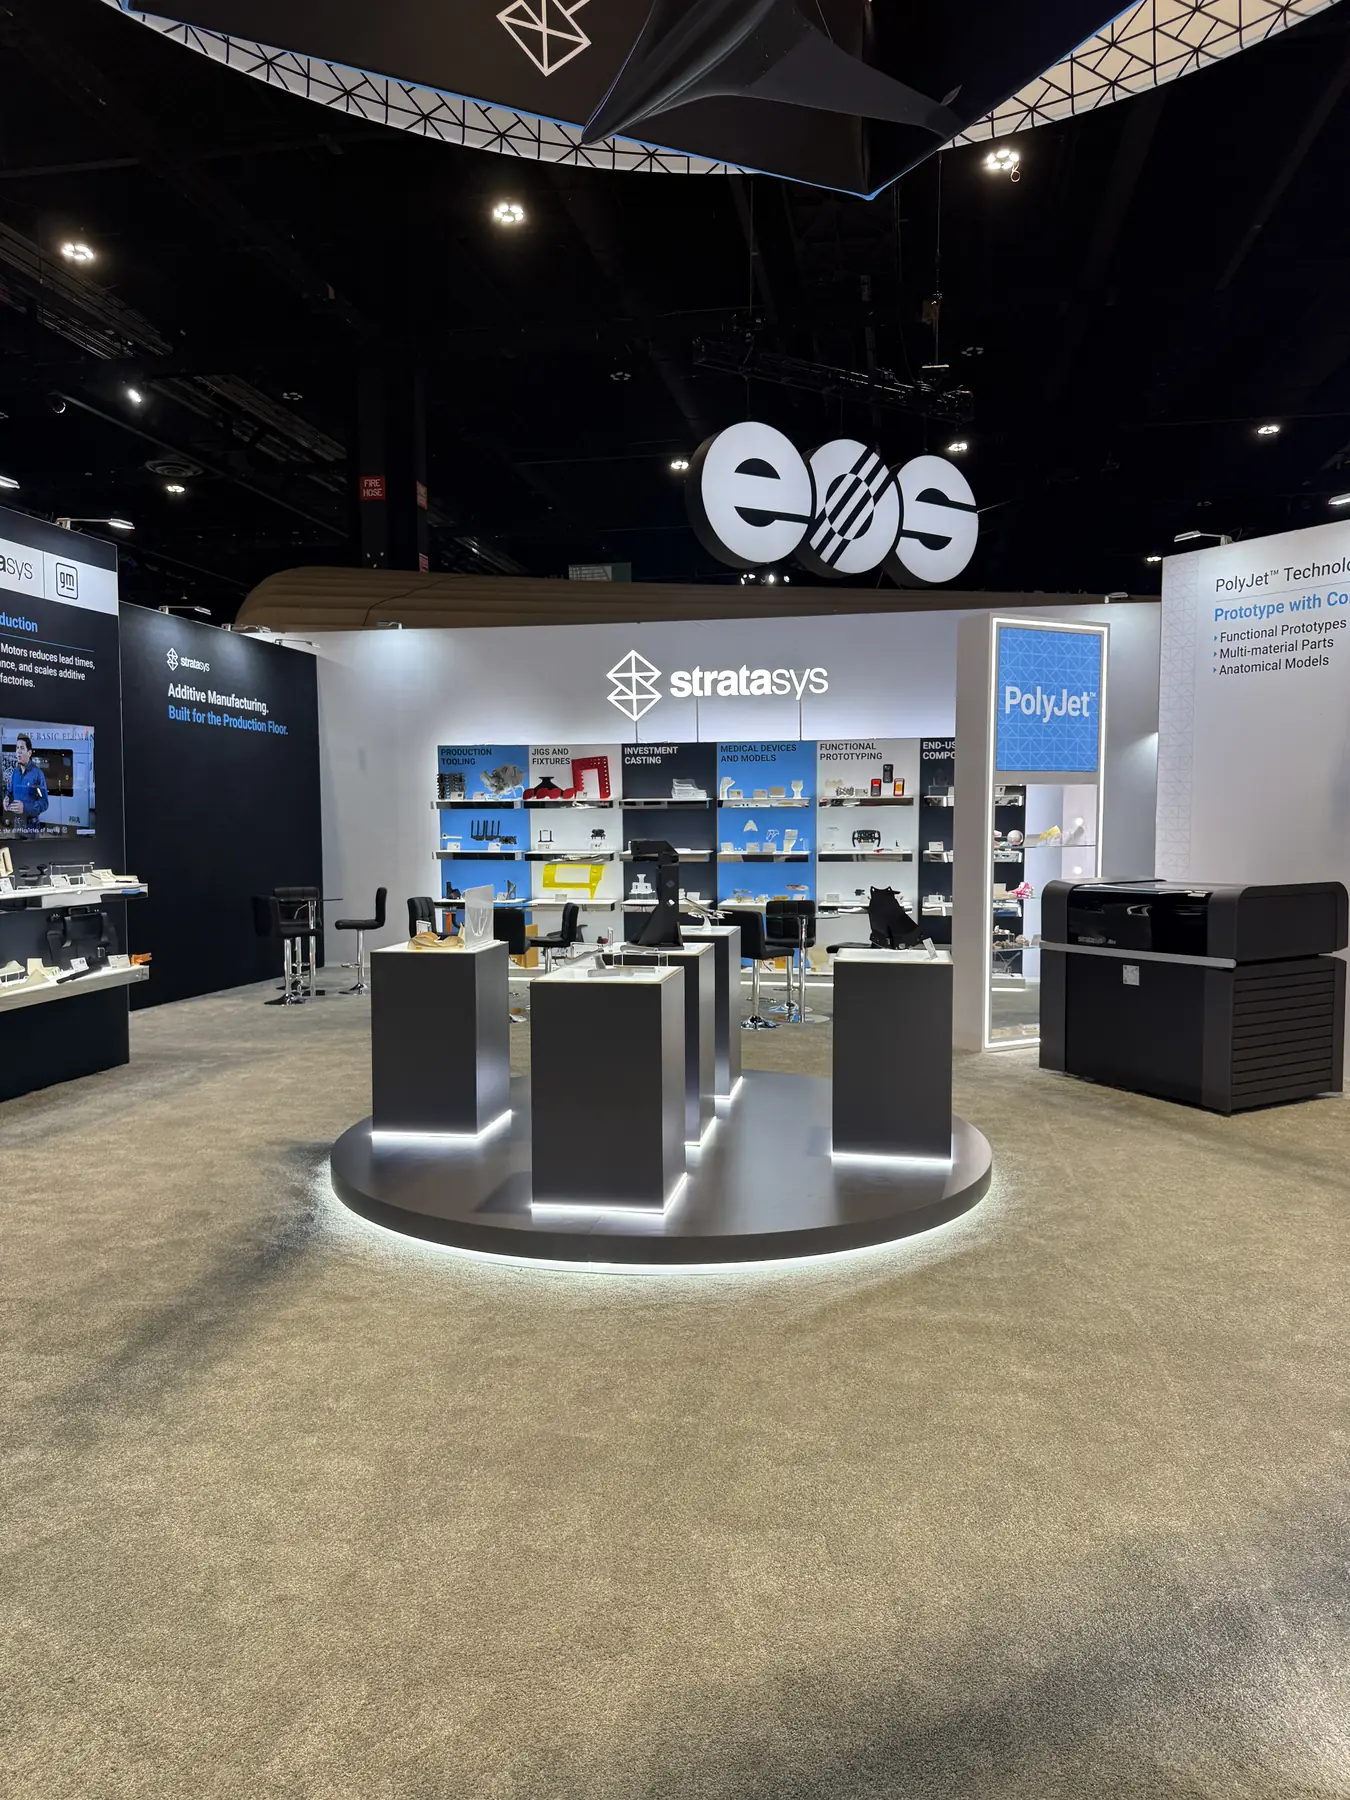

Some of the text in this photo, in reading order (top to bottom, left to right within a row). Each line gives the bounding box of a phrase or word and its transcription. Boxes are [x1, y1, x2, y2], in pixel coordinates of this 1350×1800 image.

[364, 479, 381, 487] FIRE
[363, 488, 383, 496] HOSE
[701, 421, 979, 583] eos
[1214, 591, 1350, 622] Prototype with Co
[1220, 619, 1347, 643] Functional Prototypes
[1219, 637, 1335, 659] Multi-material Parts
[0, 643, 96, 670] Motors reduces lead times,
[180, 657, 210, 672] stratasys
[1218, 654, 1330, 676] Anatomical Models
[18, 663, 33, 673] and
[34, 666, 58, 677] scales
[58, 669, 86, 681] additive
[669, 664, 829, 701] stratasys
[168, 683, 269, 716] Additive Manufacturing.
[168, 704, 288, 735] Built for the Production Floor.
[624, 746, 678, 755] INVESTMENT
[720, 743, 797, 753] MEDICAL DEVICES
[819, 742, 876, 751] FUNCTIONAL
[440, 748, 492, 756] PRODUCTION
[532, 748, 569, 756] JIGS AND
[819, 752, 883, 761] PROTOTYPING
[441, 757, 476, 766] TOOLING
[532, 757, 571, 766] FIXTURES
[624, 756, 662, 765] CASTING
[720, 754, 777, 763] AND MODELS
